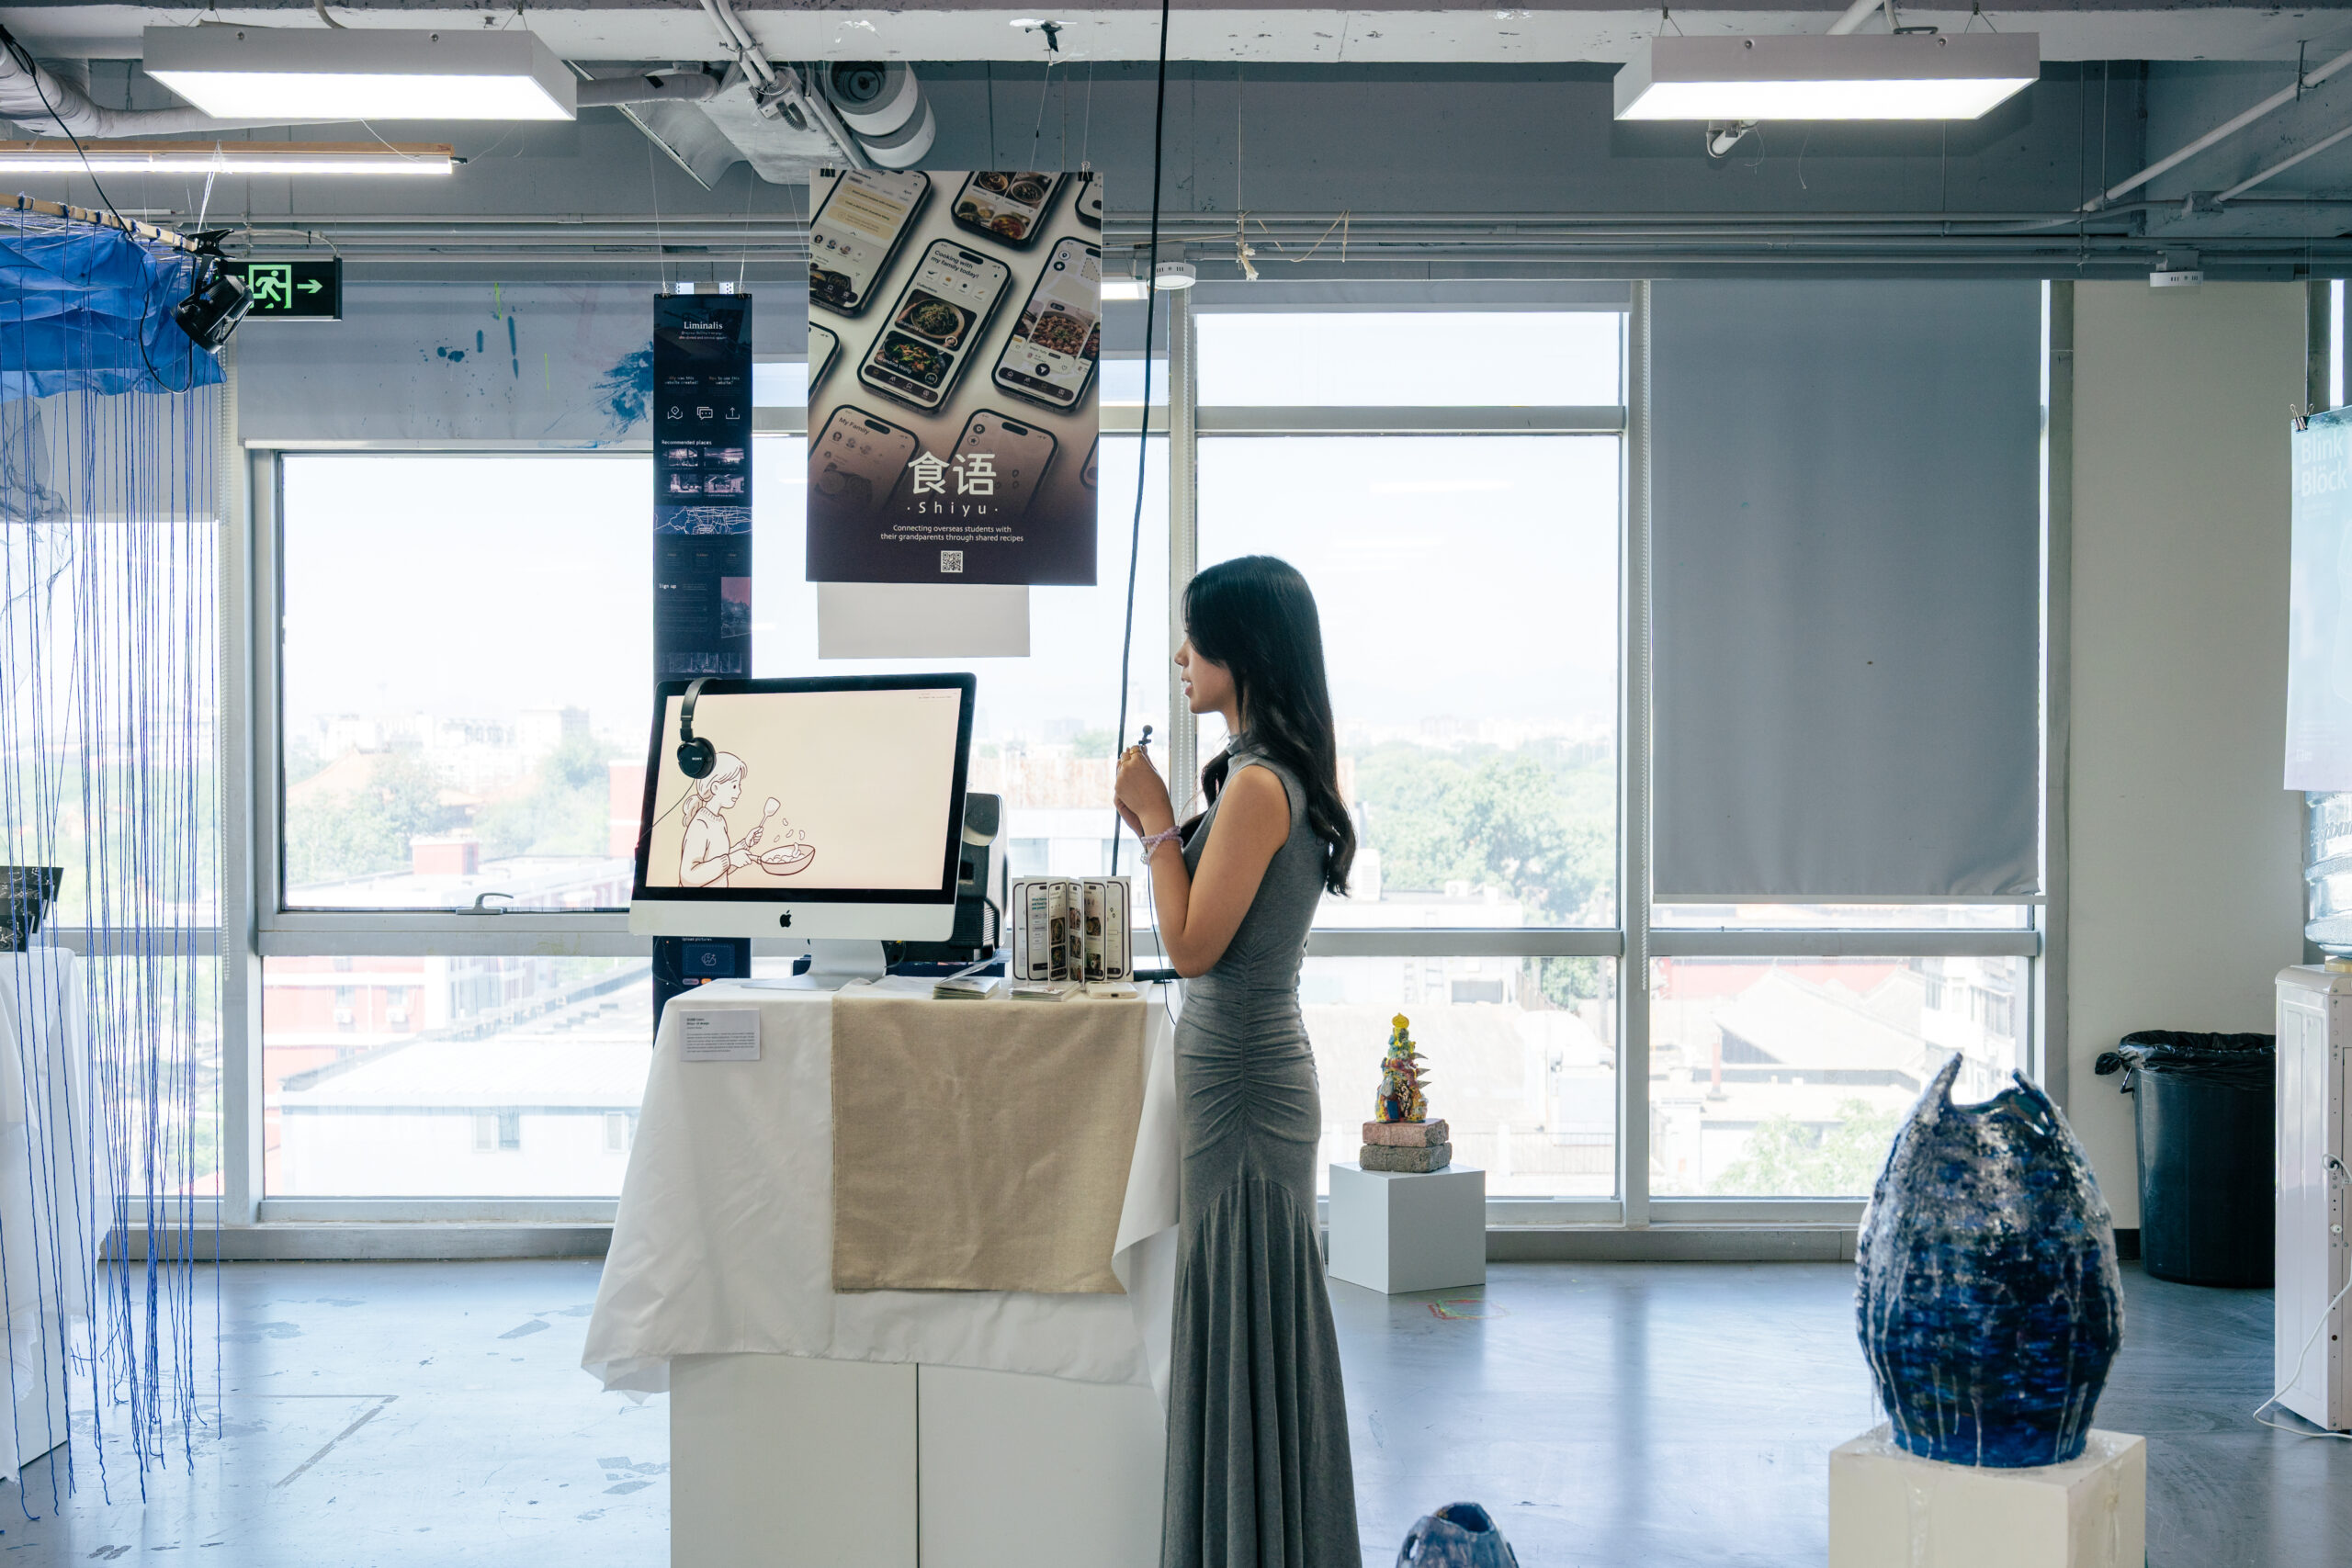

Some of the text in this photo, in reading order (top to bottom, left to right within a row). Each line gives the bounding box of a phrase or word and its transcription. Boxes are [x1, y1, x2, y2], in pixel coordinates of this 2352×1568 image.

[934, 250, 973, 269] Cooking with
[941, 258, 959, 272] family
[959, 266, 979, 279] today!
[684, 321, 723, 330] Liminalis
[839, 417, 870, 434] My Family
[2301, 428, 2344, 465] Blink
[908, 451, 997, 496] 食语
[2301, 460, 2348, 497] Blöck
[893, 525, 932, 533] Connecting
[899, 533, 944, 541] grandparents
[945, 534, 974, 542] through
[1000, 535, 1023, 543] recipes
